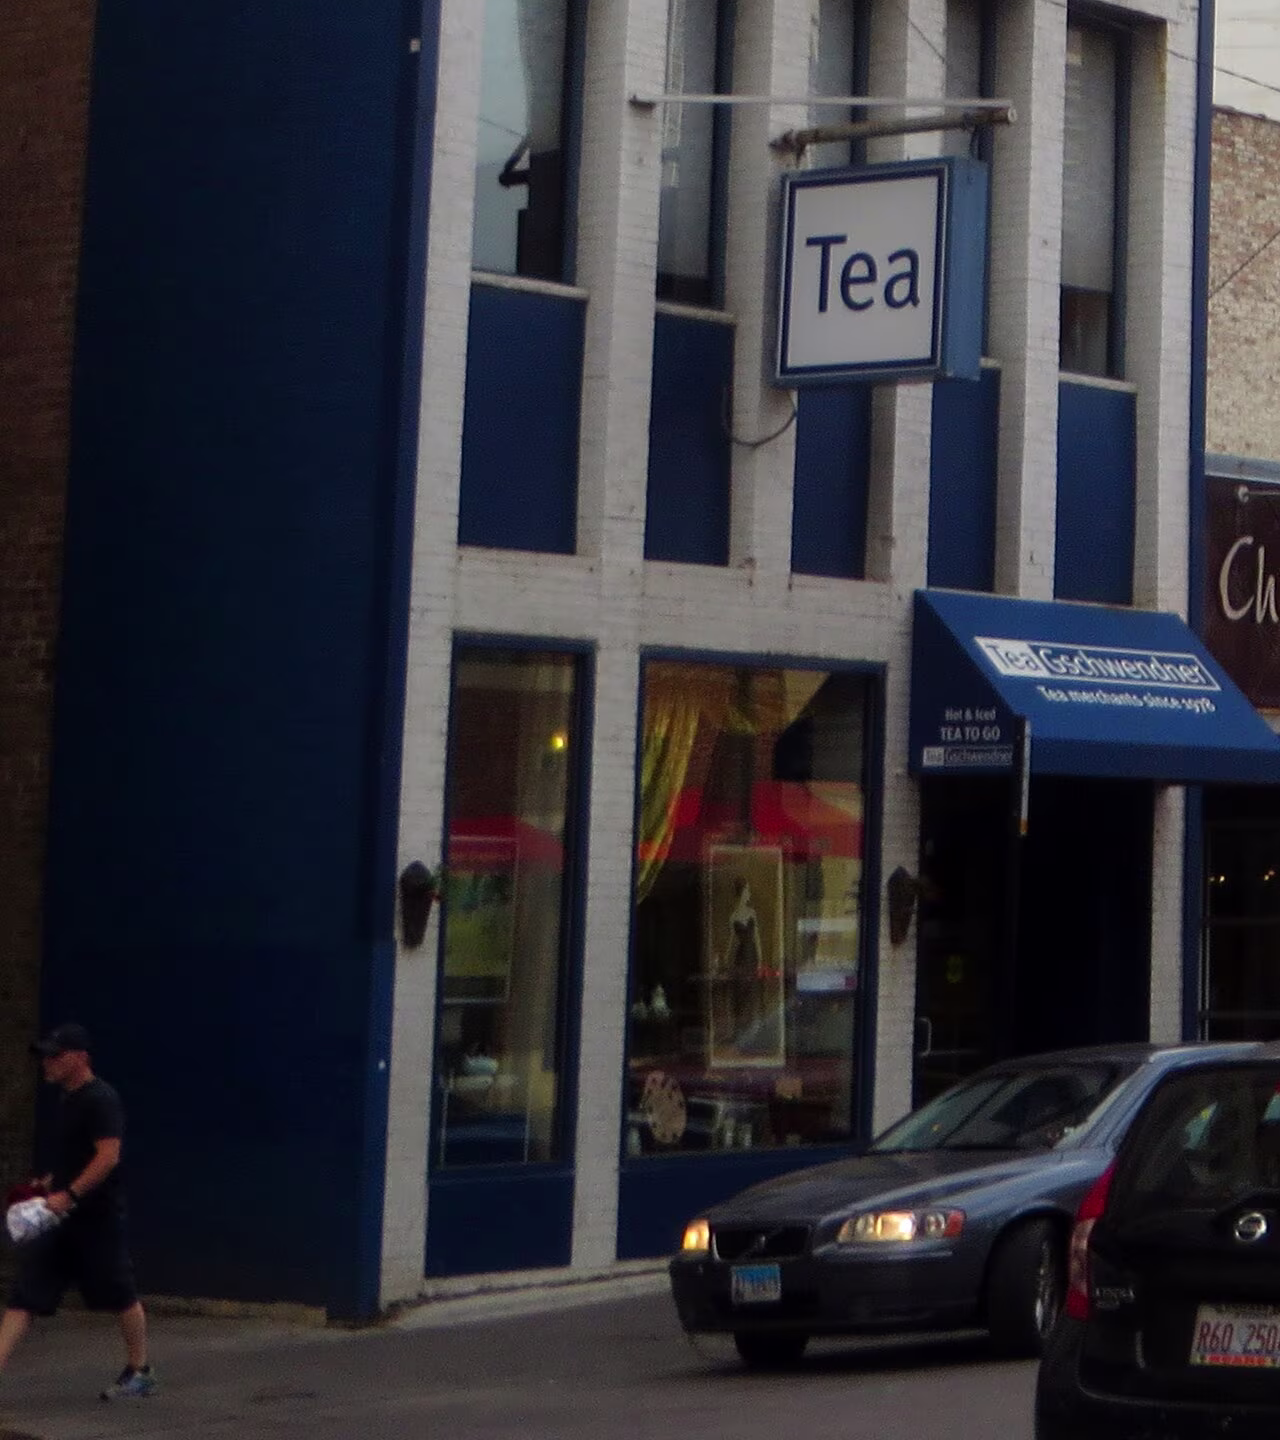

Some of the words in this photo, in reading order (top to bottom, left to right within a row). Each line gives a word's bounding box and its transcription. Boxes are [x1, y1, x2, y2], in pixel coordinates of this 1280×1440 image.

[805, 234, 921, 313] Tea
[986, 645, 1041, 671] Tea
[1039, 647, 1209, 684] Gschwendner
[944, 707, 962, 721] Hot
[1037, 685, 1068, 702] Tea
[1069, 689, 1144, 707] merchants
[1143, 692, 1180, 710] since
[1181, 698, 1217, 714] 1978
[940, 727, 962, 741] TEA
[964, 726, 980, 741] TO
[982, 725, 1001, 741] GO
[1197, 1321, 1234, 1353] R60
